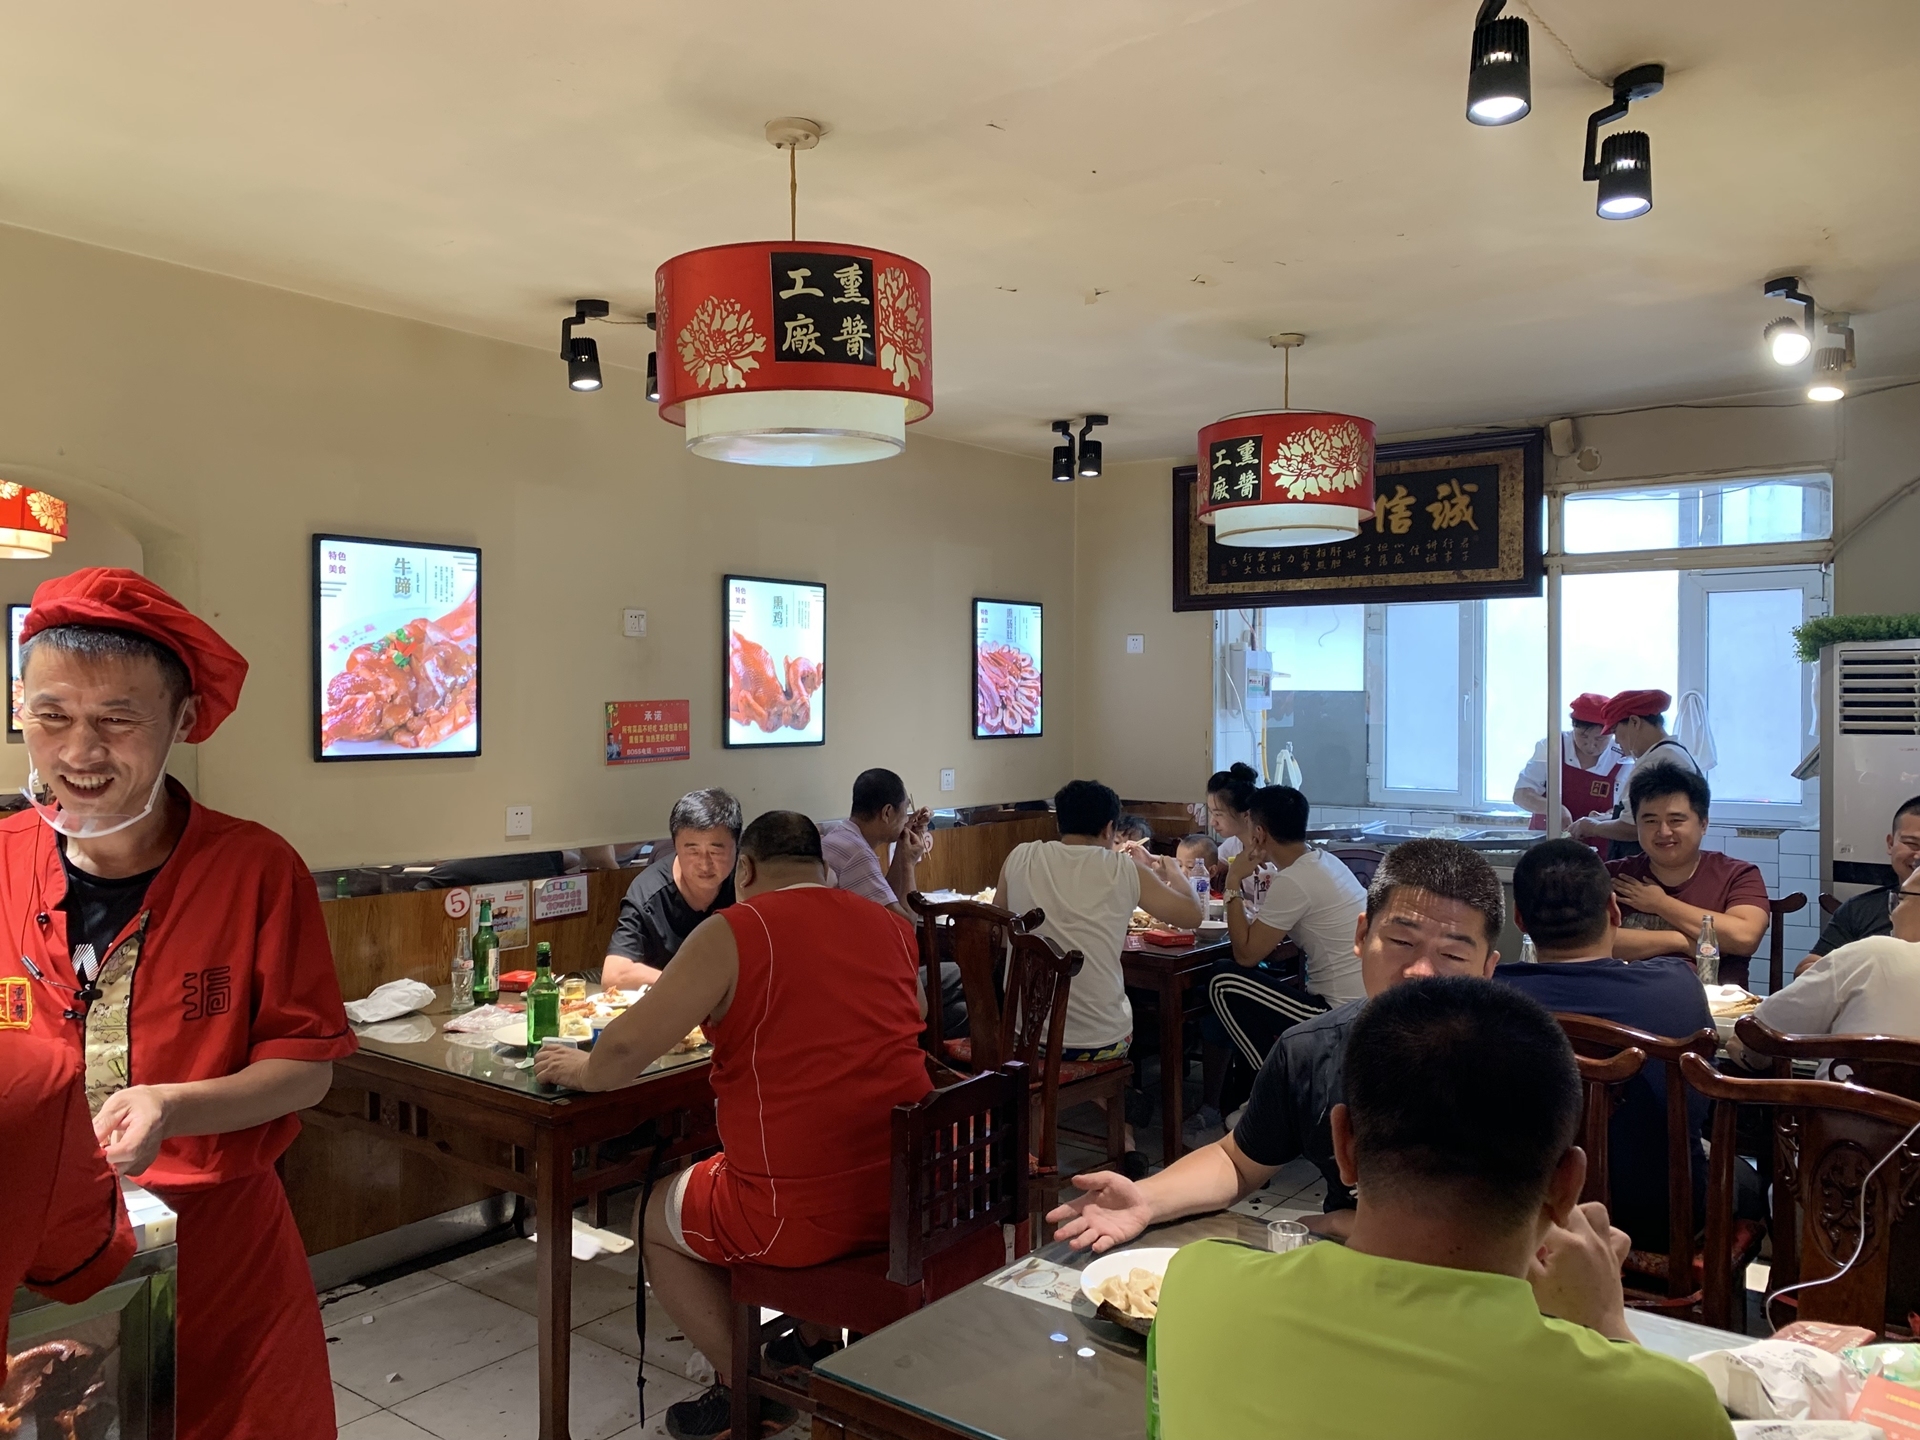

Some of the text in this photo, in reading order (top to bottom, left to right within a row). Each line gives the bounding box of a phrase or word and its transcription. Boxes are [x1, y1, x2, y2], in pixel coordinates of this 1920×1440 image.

[779, 267, 826, 356] 工廠
[1211, 448, 1232, 500] 工廠
[328, 551, 347, 562] 特色
[328, 564, 347, 575] 美食
[394, 557, 412, 595] 牛蹄
[644, 710, 662, 721] 承诺
[450, 892, 465, 914] 5
